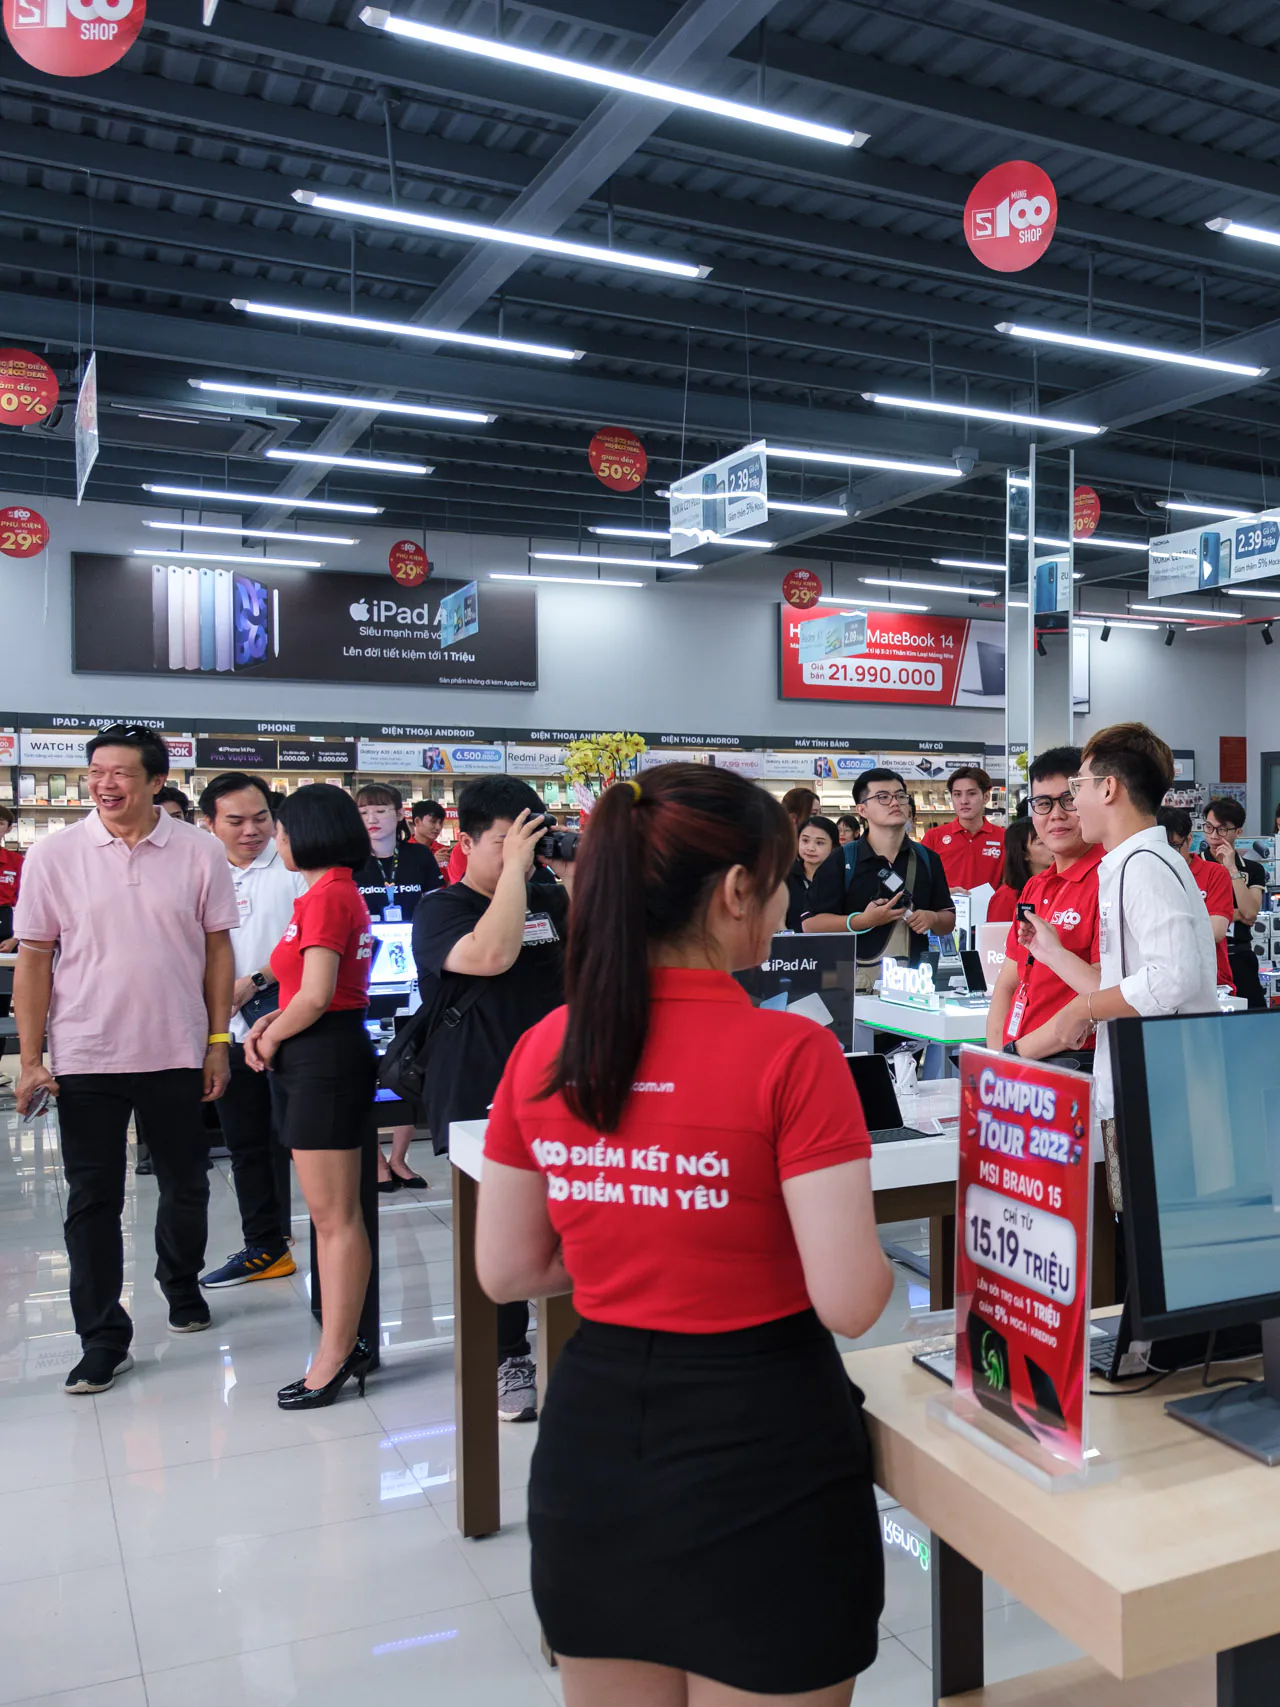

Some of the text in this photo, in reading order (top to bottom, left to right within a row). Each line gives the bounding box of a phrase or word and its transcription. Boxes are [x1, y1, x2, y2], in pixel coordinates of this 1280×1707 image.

[80, 23, 118, 40] SHOP
[1019, 228, 1042, 244] SHOP
[0, 393, 47, 415] 0%
[598, 462, 641, 483] 50%
[1238, 530, 1262, 553] 2.39
[372, 599, 429, 626] iPad
[359, 625, 382, 637] Siêu
[867, 628, 954, 649] MateBook 14
[343, 646, 362, 657] Lên
[401, 649, 426, 661] kiệm
[443, 652, 448, 661] 1
[450, 651, 476, 663] Triệu
[828, 663, 936, 687] 21.990.000
[53, 717, 79, 727] IPAD
[257, 723, 296, 733] IPHONE
[381, 726, 475, 737] ĐIỆN THOẠI ANDROID
[531, 731, 577, 741] ĐIỆN THOẠI
[661, 735, 740, 745] ĐIỆN THOẠI ANDROID
[795, 738, 810, 748] MÁY
[30, 741, 76, 751] WATCH
[507, 752, 556, 763] Redmi Pad
[358, 886, 386, 896] Galax
[771, 958, 818, 972] iPad Air
[979, 1067, 1057, 1122] CAMPUS
[977, 1109, 1072, 1166] TOUR 2022
[570, 1137, 625, 1169] ĐIỂM
[631, 1144, 669, 1173] KẾT
[676, 1151, 730, 1178] NỐI
[571, 1172, 729, 1210] ĐIỂM TIN YÊU
[979, 1160, 1062, 1209] MSI BRAVO 15
[1003, 1207, 1018, 1226] CHỈ
[970, 1215, 1071, 1296] 15.19 TRIỆU
[994, 1304, 1008, 1325] 5%
[1025, 1298, 1031, 1314] 1
[1033, 1300, 1061, 1329] TRIỆU
